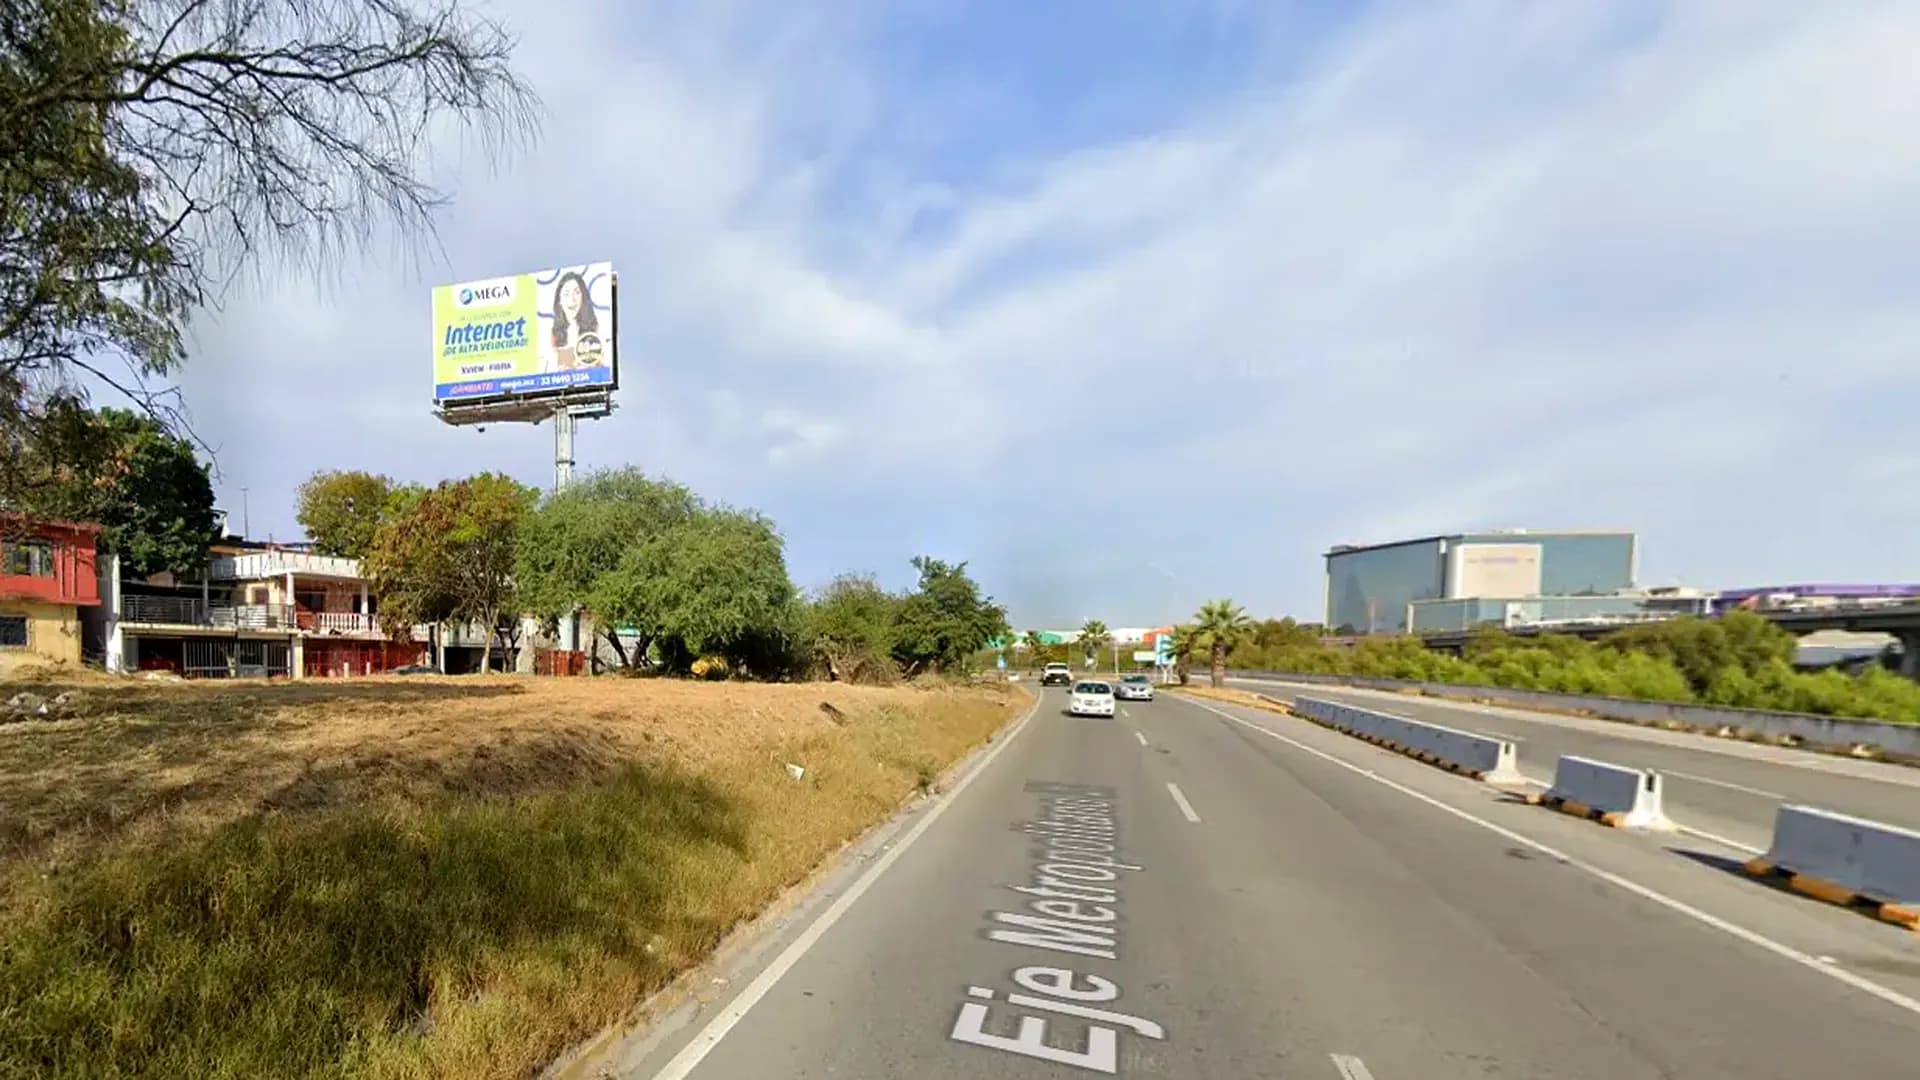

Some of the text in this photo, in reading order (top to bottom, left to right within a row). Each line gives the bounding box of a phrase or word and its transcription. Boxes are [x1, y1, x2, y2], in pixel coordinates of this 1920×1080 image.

[474, 286, 510, 300] MEGA
[445, 316, 526, 345] Internet
[459, 341, 478, 354] ALTA
[541, 376, 550, 385] 33
